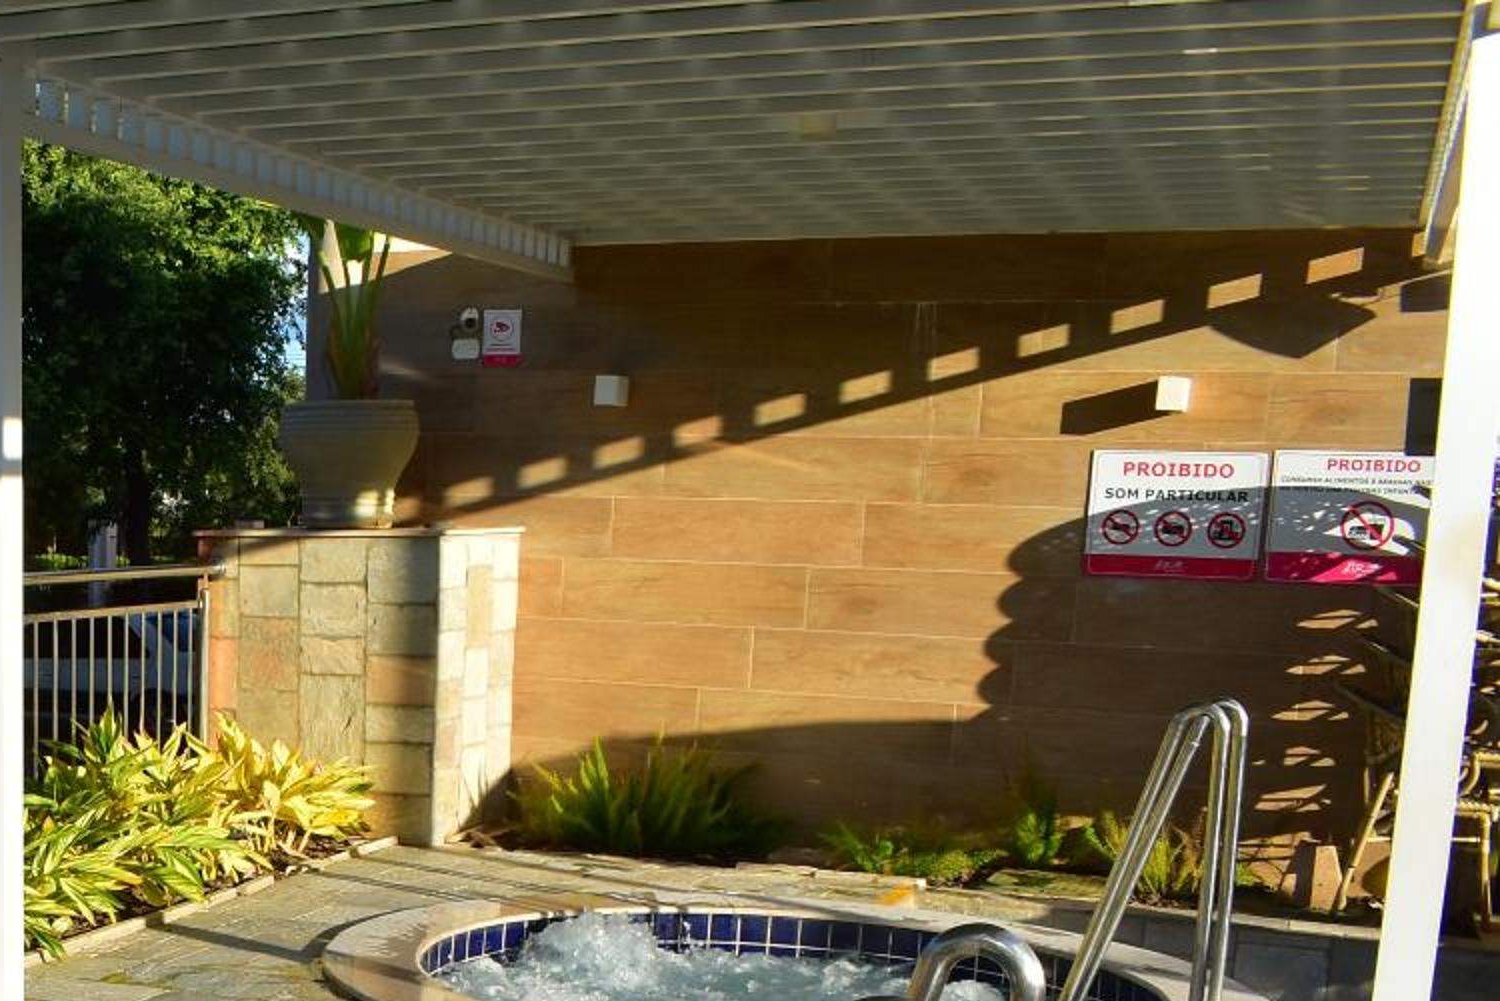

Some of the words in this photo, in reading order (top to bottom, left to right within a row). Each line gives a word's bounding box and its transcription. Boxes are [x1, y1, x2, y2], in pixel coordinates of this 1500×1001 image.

[1123, 462, 1235, 479] PROIBIDO
[1326, 459, 1422, 473] PROIBIDO
[1104, 487, 1139, 500] SOM
[1145, 489, 1249, 503] PARTICULAR
